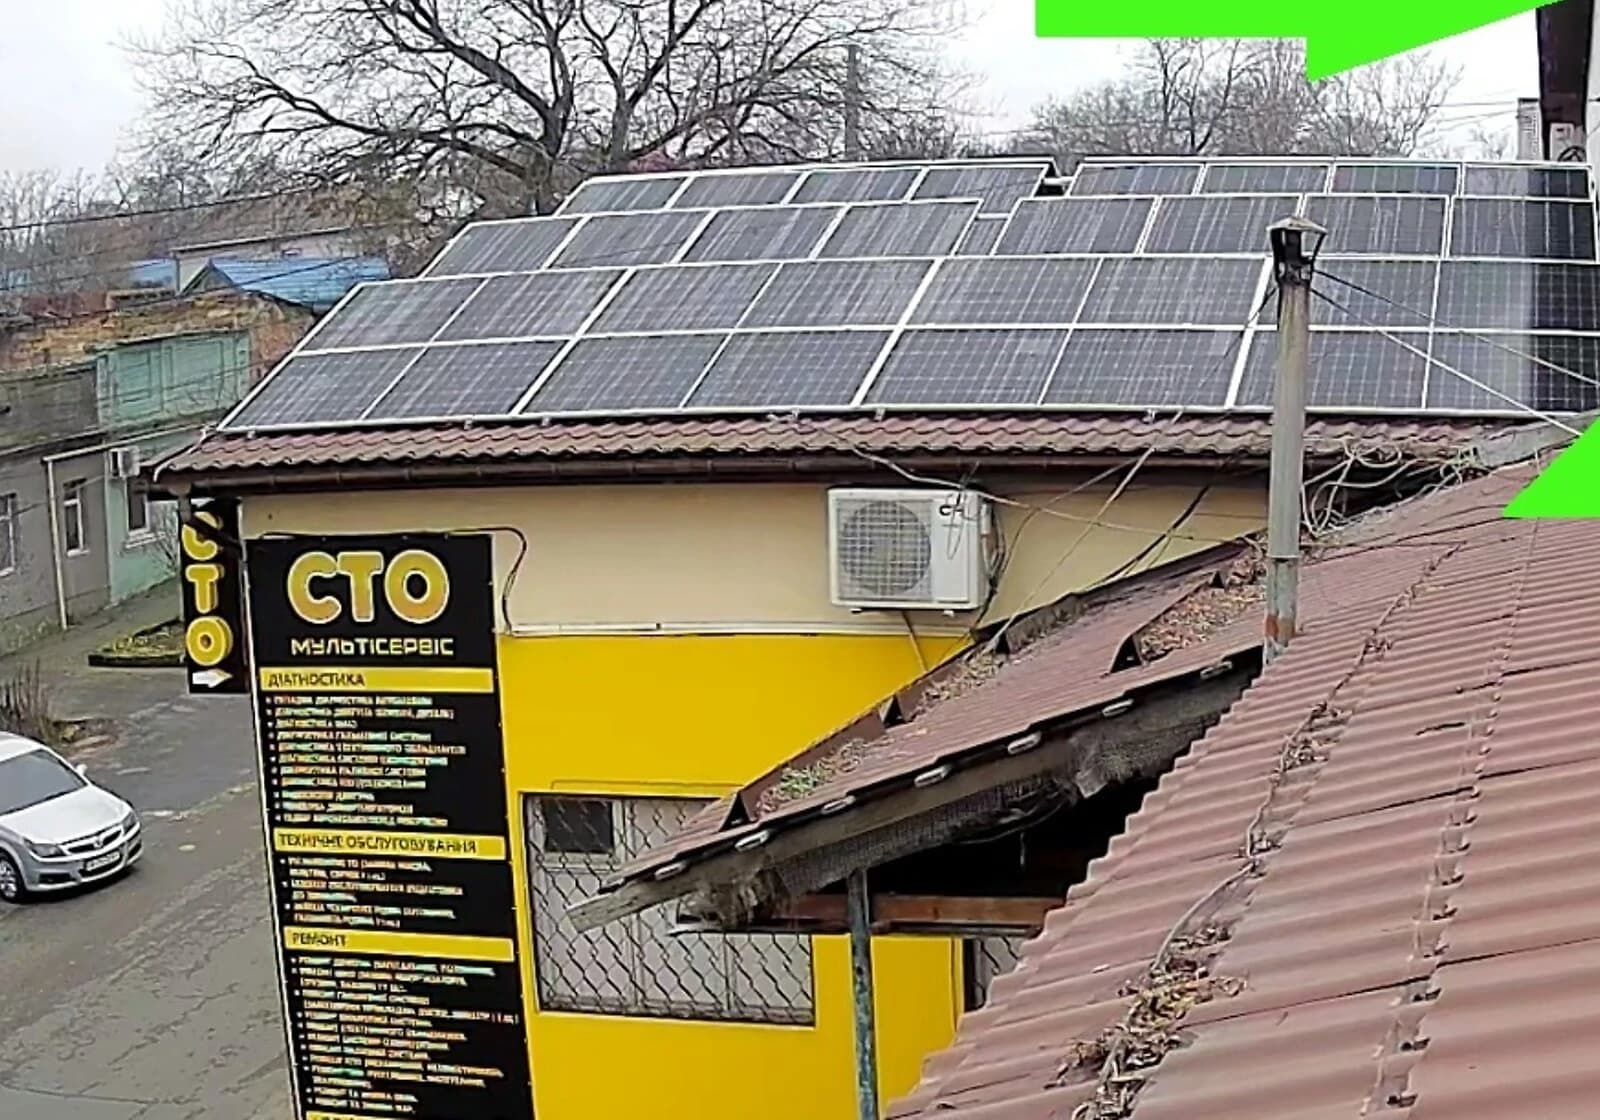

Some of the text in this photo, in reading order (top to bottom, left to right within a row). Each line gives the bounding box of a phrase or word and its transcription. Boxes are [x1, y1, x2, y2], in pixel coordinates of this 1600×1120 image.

[287, 549, 450, 624] СТО
[291, 637, 454, 656] МУЛЬТІСЕРВІС
[268, 672, 366, 688] ДІАГНОСТИКА
[292, 931, 347, 947] РЕМОНТ
